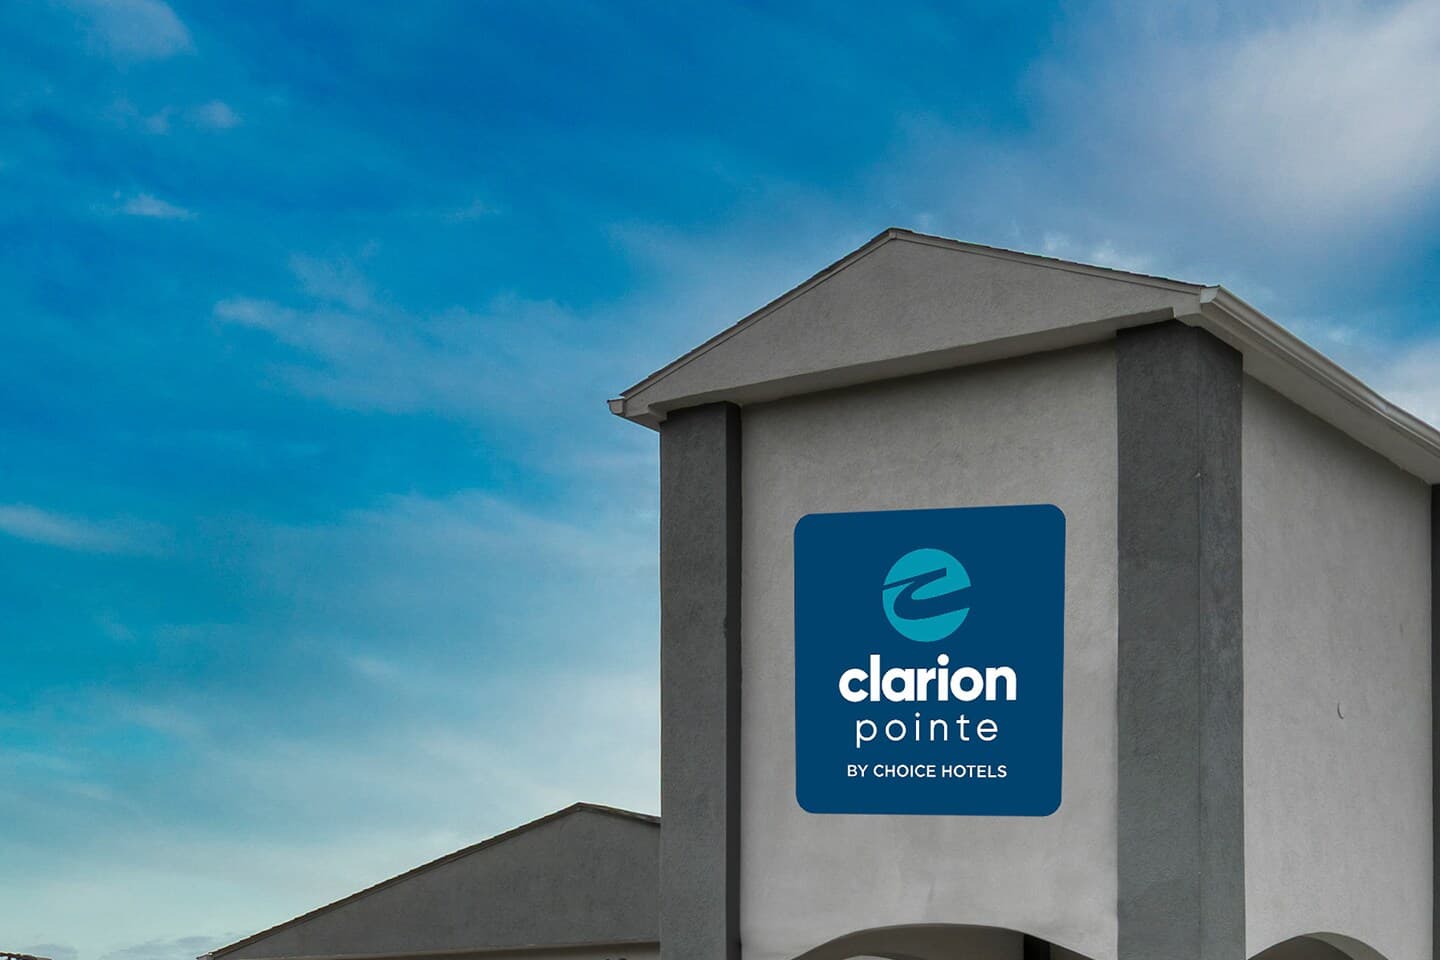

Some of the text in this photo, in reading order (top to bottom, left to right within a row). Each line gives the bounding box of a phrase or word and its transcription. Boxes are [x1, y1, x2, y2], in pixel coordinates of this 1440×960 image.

[839, 653, 1017, 702] clarion
[856, 712, 999, 749] pointe
[847, 764, 1008, 779] BY CHOICE HOTELS
